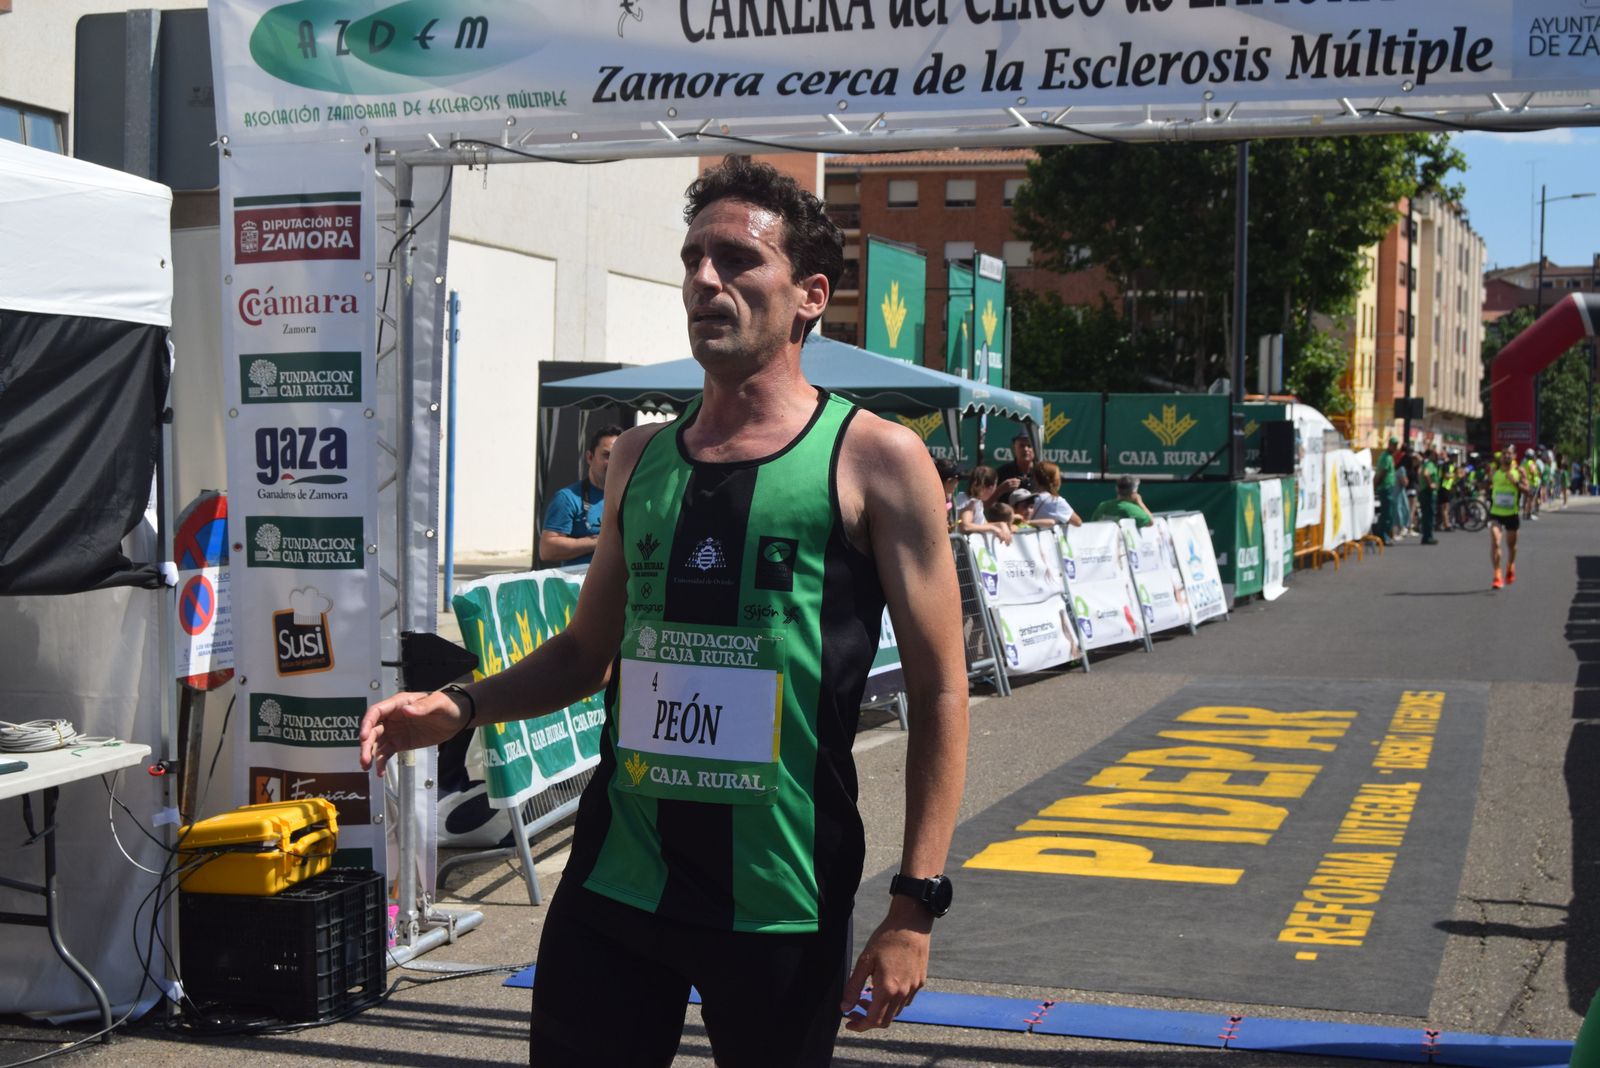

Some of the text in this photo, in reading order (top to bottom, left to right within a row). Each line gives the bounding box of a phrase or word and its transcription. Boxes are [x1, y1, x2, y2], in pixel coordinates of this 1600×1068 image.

[1529, 35, 1560, 56] DE
[592, 26, 1494, 103] Zamora cerca de la Esclerosis Múltiple
[244, 90, 567, 127] ASOCIACIÓN ZAMORANA DE ESCLEROSIS MÚLTIPLE
[262, 215, 353, 231] DIPUTACIÓN DE
[261, 230, 354, 251] ZAMORA
[282, 324, 317, 335] Zamora
[279, 371, 354, 384] FUNDACION
[279, 384, 354, 397] CAJA RURAL
[255, 427, 348, 485] gaza
[929, 446, 968, 460] URAL
[1119, 451, 1221, 465] CAJA RURAL
[257, 488, 348, 500] Ganaderos de Zamora
[282, 537, 355, 551] FUNDACION
[282, 551, 356, 563] CAJA RURAL
[279, 626, 324, 660] Susi
[660, 630, 759, 651] FUNDACION
[660, 646, 758, 667] CAJA RURAL
[652, 672, 658, 692] 4
[282, 714, 360, 728] FUNDACION
[652, 693, 723, 746] PEÓN
[282, 727, 361, 741] CAJA RURAL
[650, 766, 766, 791] CAJA RURAL
[962, 705, 1358, 885] PIDEPAR
[1332, 782, 1422, 846] INTEGRAL
[1277, 852, 1397, 946] REFORMA
